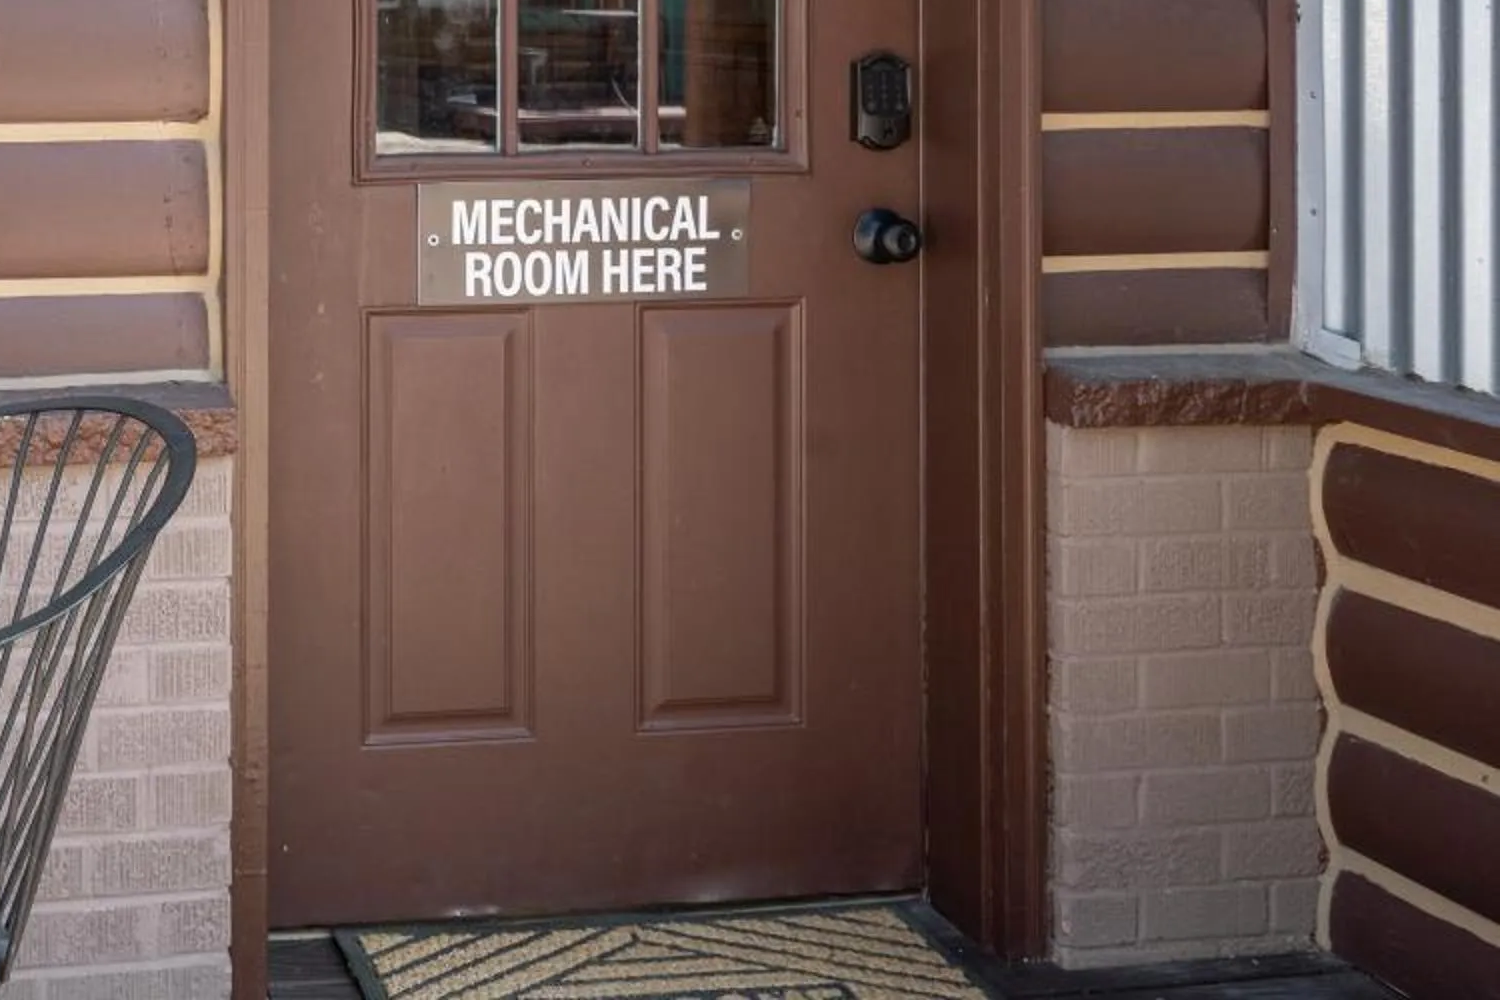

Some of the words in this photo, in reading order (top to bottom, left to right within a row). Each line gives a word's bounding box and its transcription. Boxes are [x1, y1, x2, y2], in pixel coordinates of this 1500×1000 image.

[452, 196, 720, 246] MECHANICAL
[464, 251, 589, 297] ROOM
[602, 247, 708, 294] HERE
